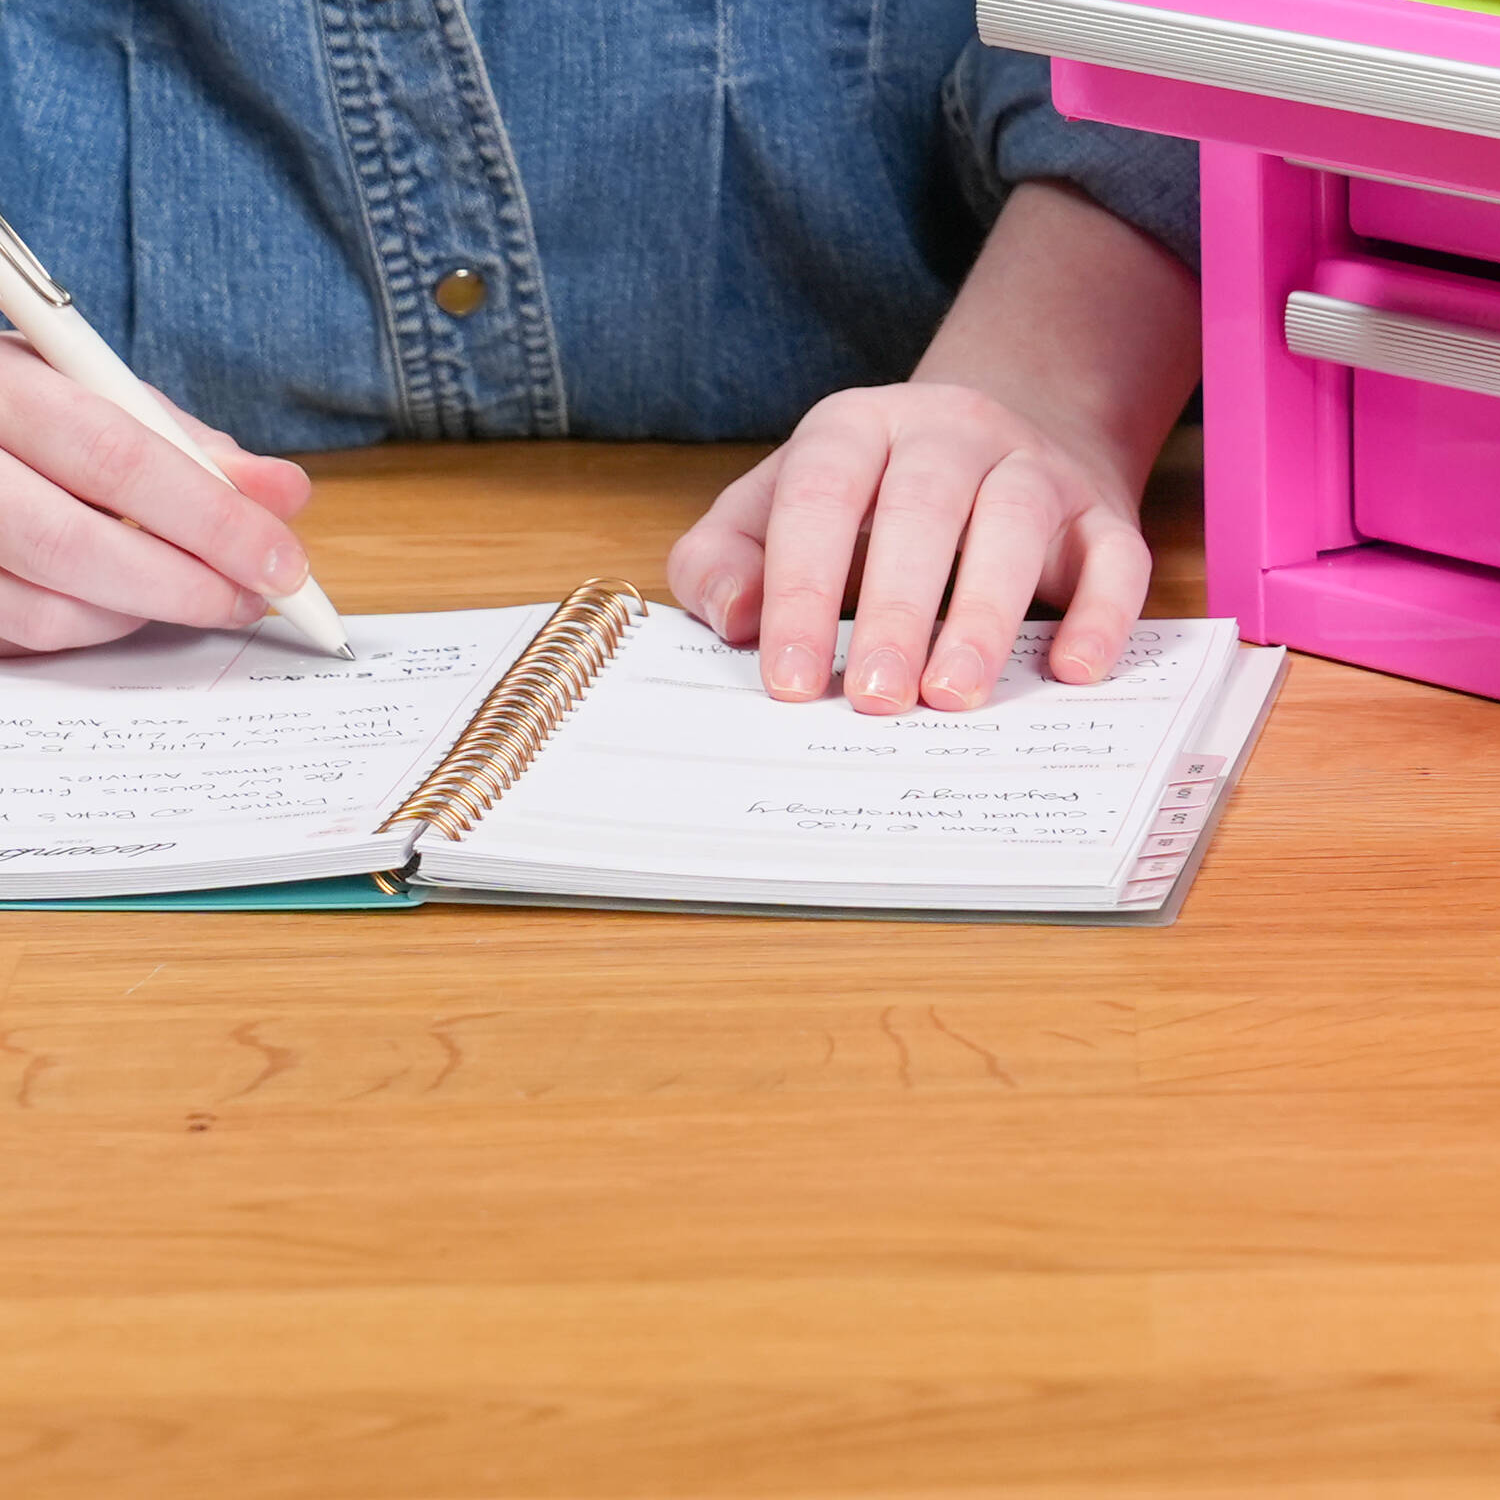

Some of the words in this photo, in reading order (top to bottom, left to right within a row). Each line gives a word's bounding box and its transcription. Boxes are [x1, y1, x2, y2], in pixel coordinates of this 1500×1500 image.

[883, 720, 1000, 732] Dinner
[1029, 720, 1113, 731] 4:00
[807, 744, 897, 756] Exam
[1014, 742, 1112, 756] Psych
[1187, 764, 1204, 774] DEC
[900, 789, 1079, 802] Psychology
[1176, 788, 1192, 799] NOV
[1170, 812, 1187, 825] OCT
